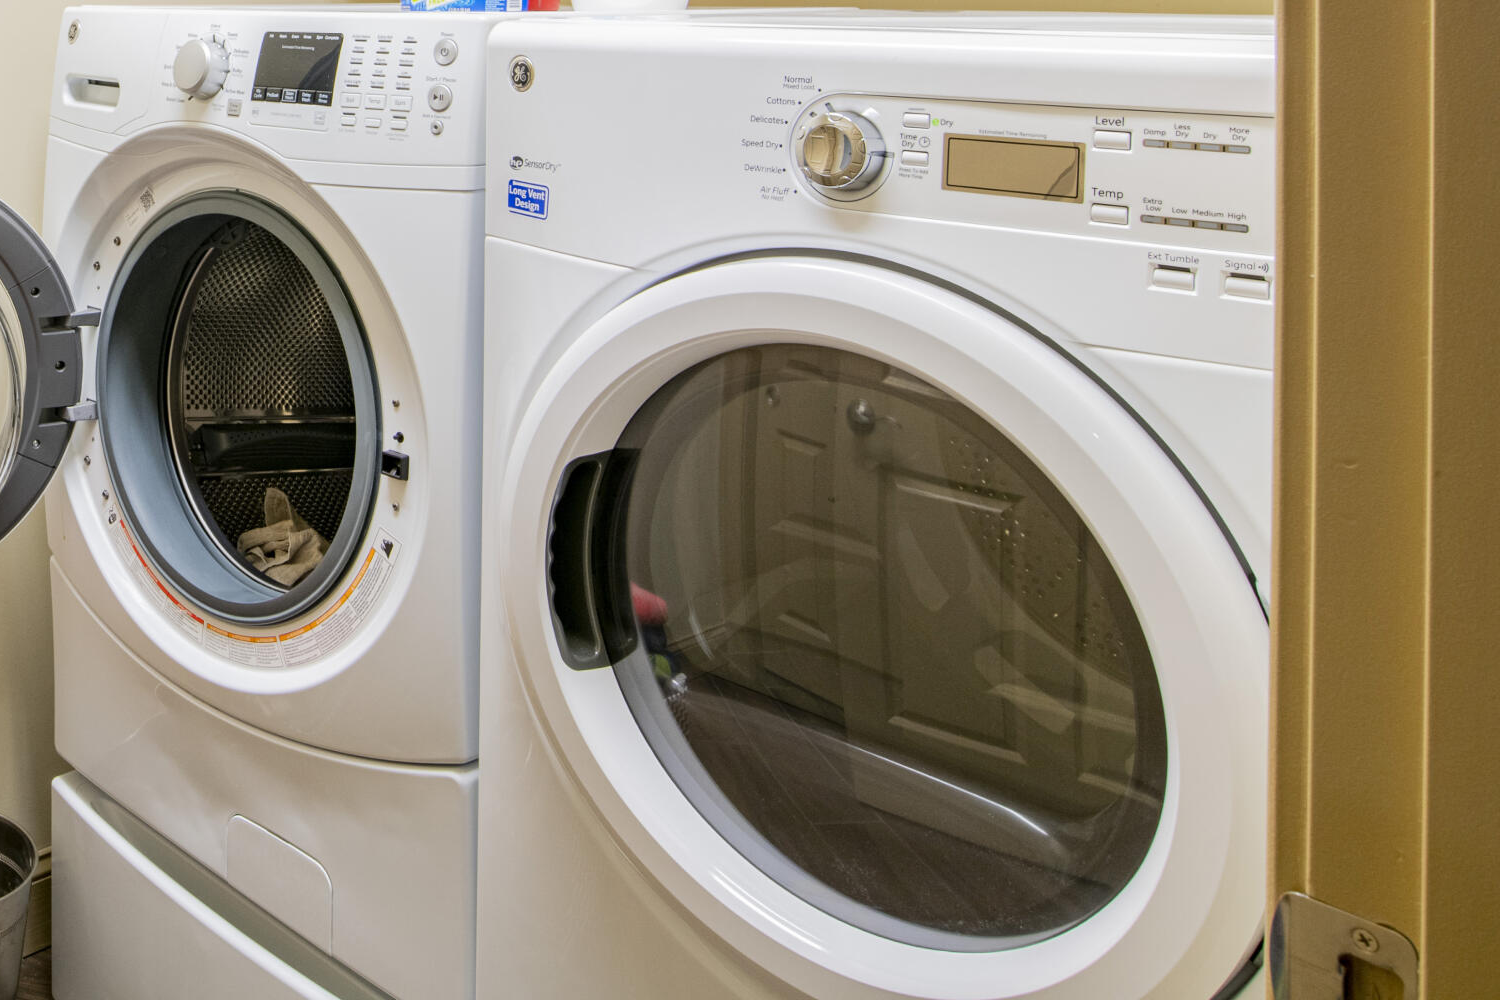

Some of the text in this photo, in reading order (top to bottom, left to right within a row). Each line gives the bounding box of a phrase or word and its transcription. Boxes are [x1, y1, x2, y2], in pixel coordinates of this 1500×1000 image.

[784, 75, 813, 84] Normal
[766, 97, 796, 106] Cottons
[750, 115, 784, 125] Delicates
[940, 118, 954, 128] Dry
[1095, 115, 1125, 127] Level
[1174, 123, 1191, 131] Less
[1229, 126, 1250, 135] More
[900, 133, 918, 141] Time
[1143, 128, 1167, 137] Damp
[1176, 130, 1190, 139] Dry
[1203, 132, 1217, 141] Dry
[1232, 133, 1247, 143] Dry
[741, 138, 779, 150] Speed Dry
[901, 140, 915, 149] Dry
[744, 163, 782, 174] DeWrinkle
[509, 185, 545, 200] Long Vent
[760, 185, 790, 195] Air Fluff
[1092, 187, 1124, 200] Temp
[515, 197, 540, 211] Design
[1143, 197, 1163, 205] Extra
[1146, 204, 1162, 212] Low
[1171, 207, 1247, 221] Low Medium High
[1148, 252, 1199, 264] Ext Tumble
[1225, 259, 1256, 271] Signal
